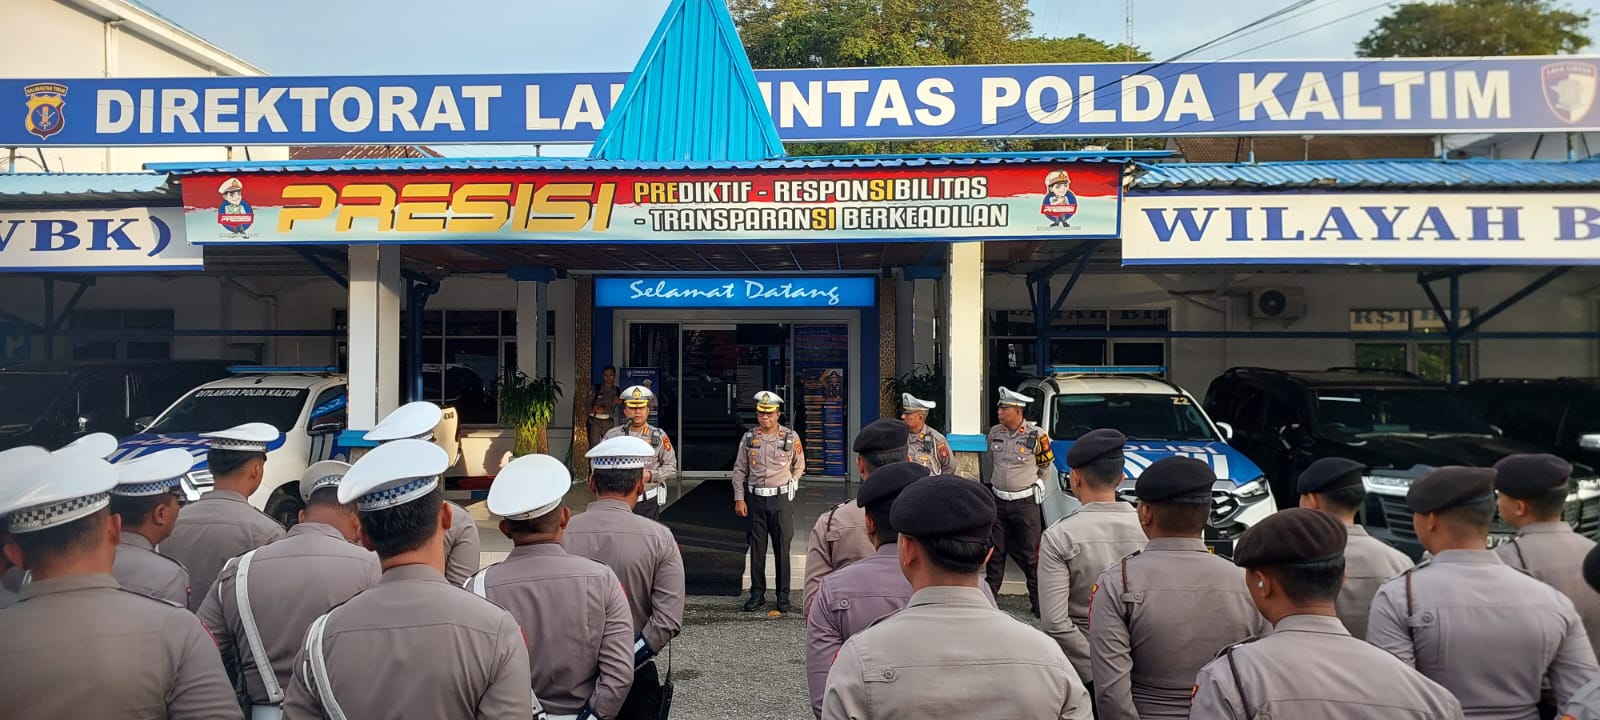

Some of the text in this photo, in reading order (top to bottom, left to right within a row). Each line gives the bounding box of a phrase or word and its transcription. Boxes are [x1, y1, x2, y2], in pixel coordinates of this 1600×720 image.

[95, 84, 502, 134] DIREKTORAT
[981, 74, 1215, 125] POLDA
[1238, 69, 1512, 120] KALTIM
[634, 181, 752, 204] PREDIKTIF
[774, 176, 988, 203] RESPONSIBILITAS
[276, 183, 617, 232] PRESISI
[650, 208, 836, 232] TRANSPARANSI
[842, 204, 1008, 230] BERKEADILAN
[1140, 206, 1526, 243] WILAYAH
[629, 279, 840, 305] Selamat Datang
[239, 388, 266, 396] POLDA
[265, 388, 300, 397] KALTIM
[1122, 442, 1218, 454] OLISI
